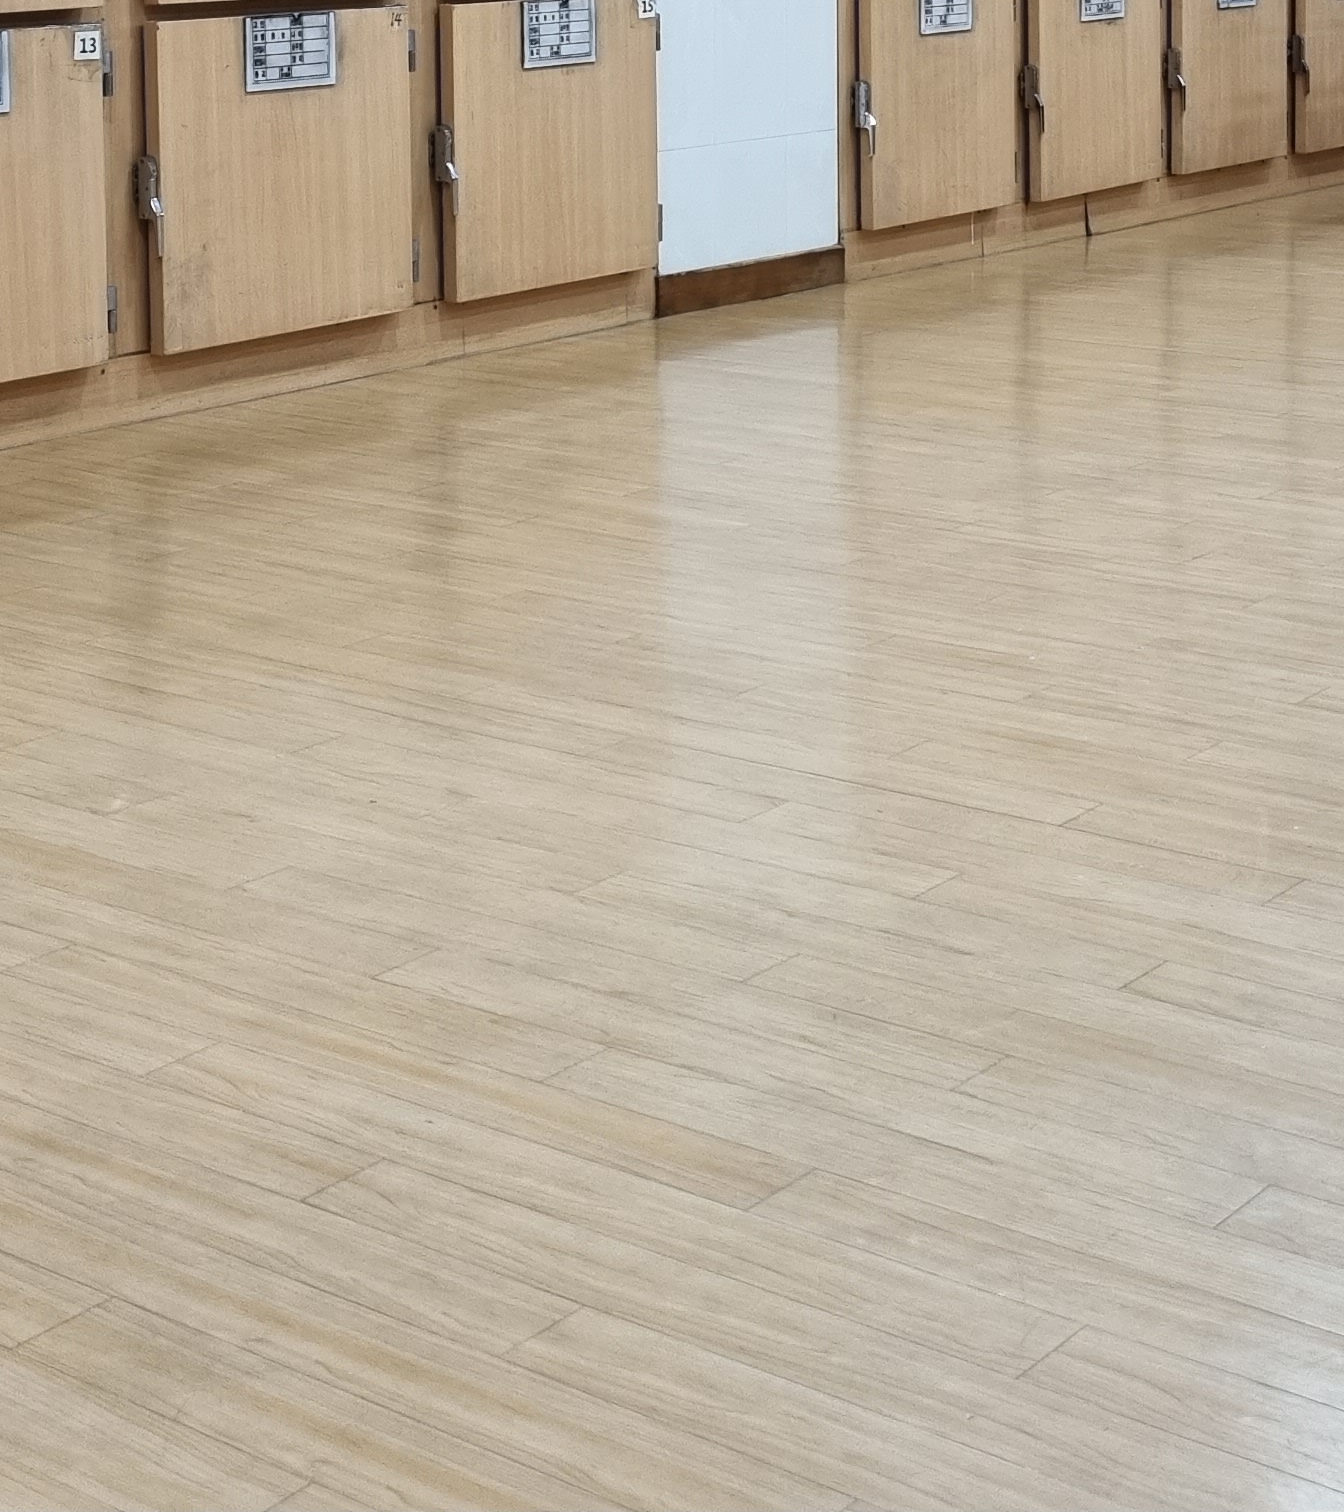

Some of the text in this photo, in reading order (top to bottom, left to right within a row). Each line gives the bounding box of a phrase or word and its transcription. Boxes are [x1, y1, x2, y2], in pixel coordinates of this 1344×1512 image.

[642, 0, 653, 13] 15
[391, 13, 402, 27] 14
[79, 37, 96, 54] 13
